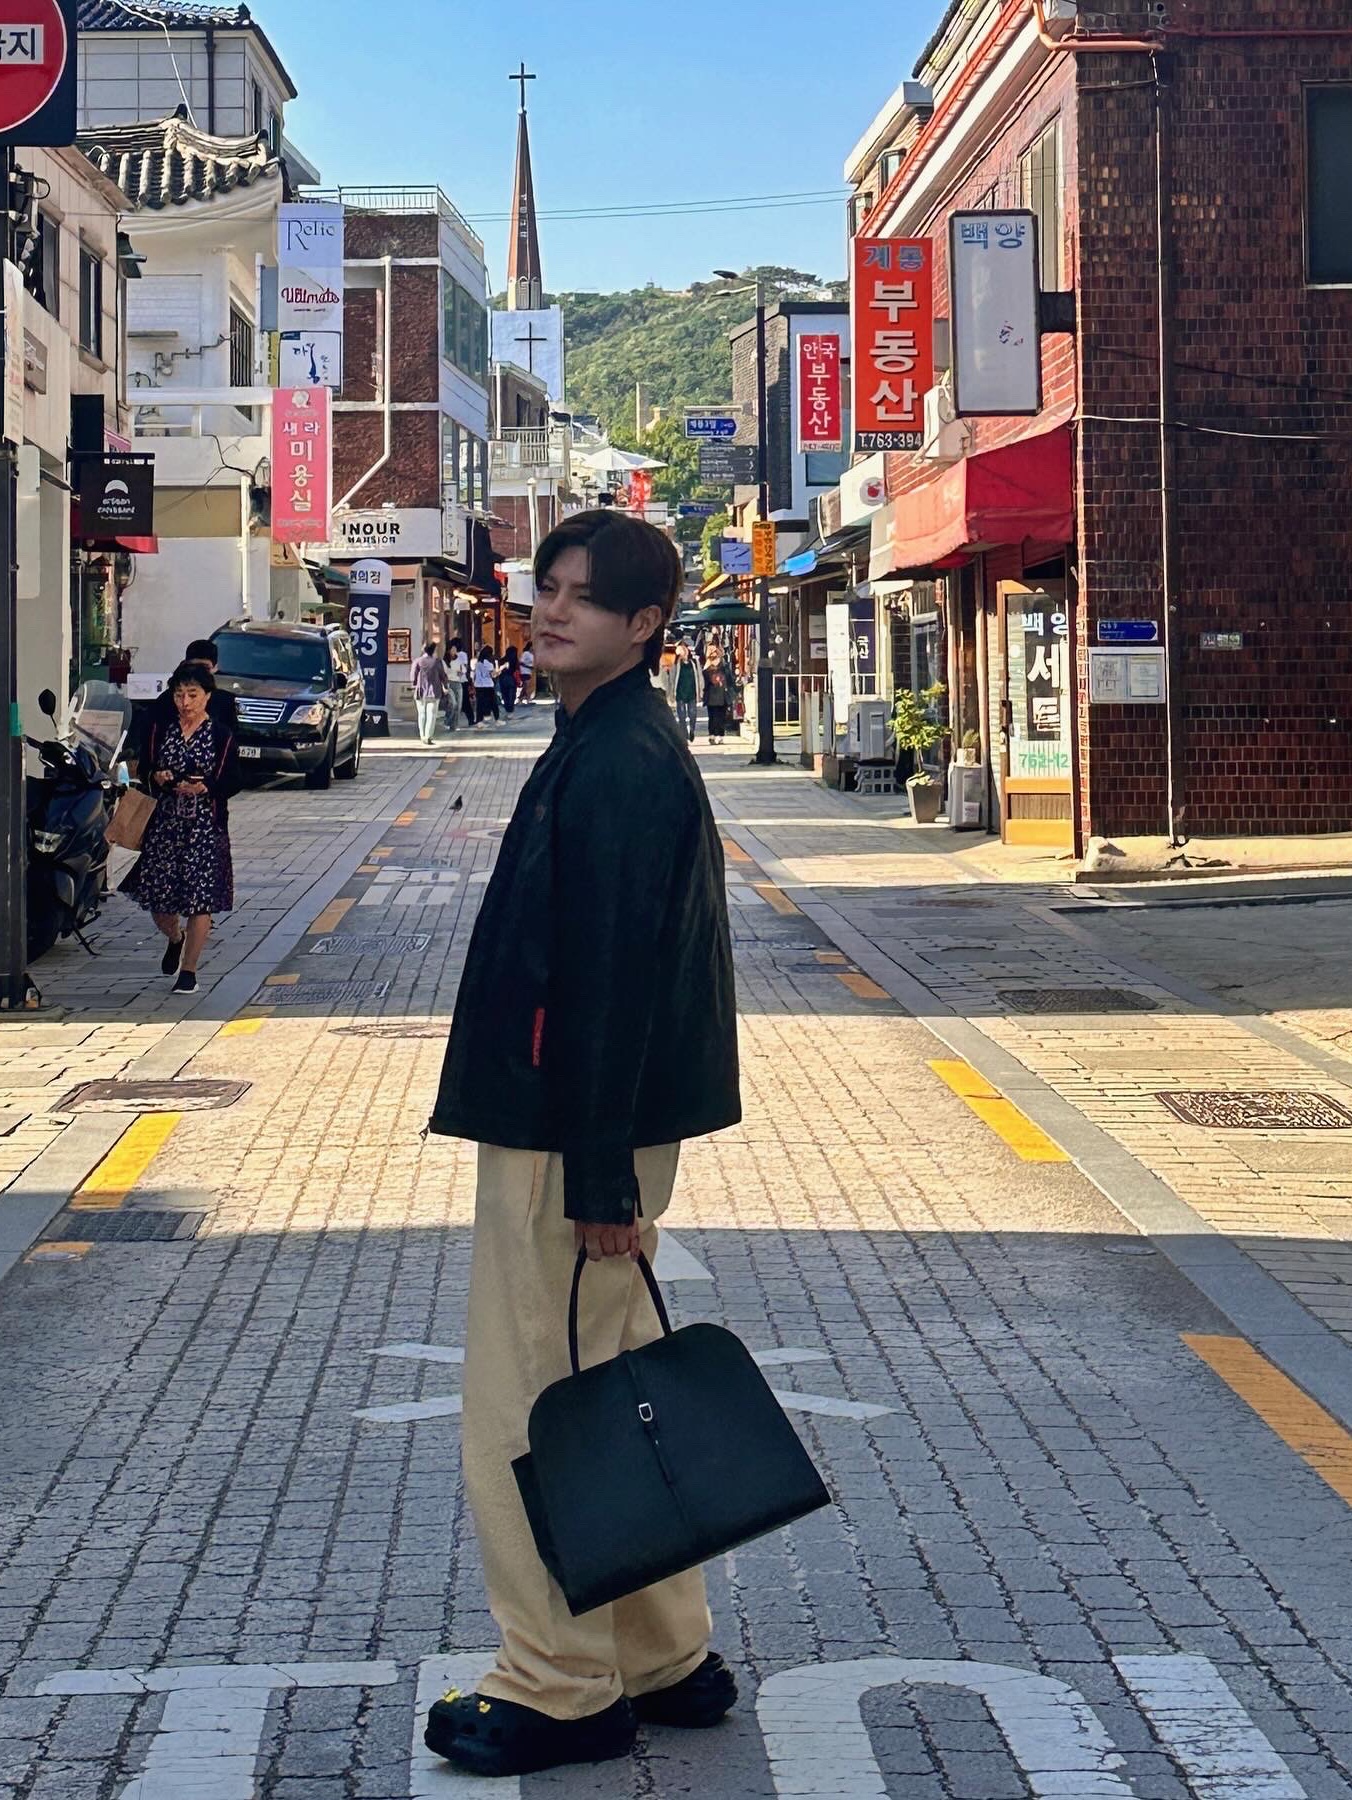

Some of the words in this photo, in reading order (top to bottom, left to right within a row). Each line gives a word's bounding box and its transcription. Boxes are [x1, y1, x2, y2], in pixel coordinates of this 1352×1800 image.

[0, 28, 36, 60] 지
[961, 222, 1025, 250] 백양
[803, 342, 836, 360] 안국
[868, 280, 919, 422] 부동산
[807, 362, 832, 435] 부동산
[289, 440, 315, 512] 미용실
[342, 522, 400, 536] INOUR
[348, 606, 380, 630] GS
